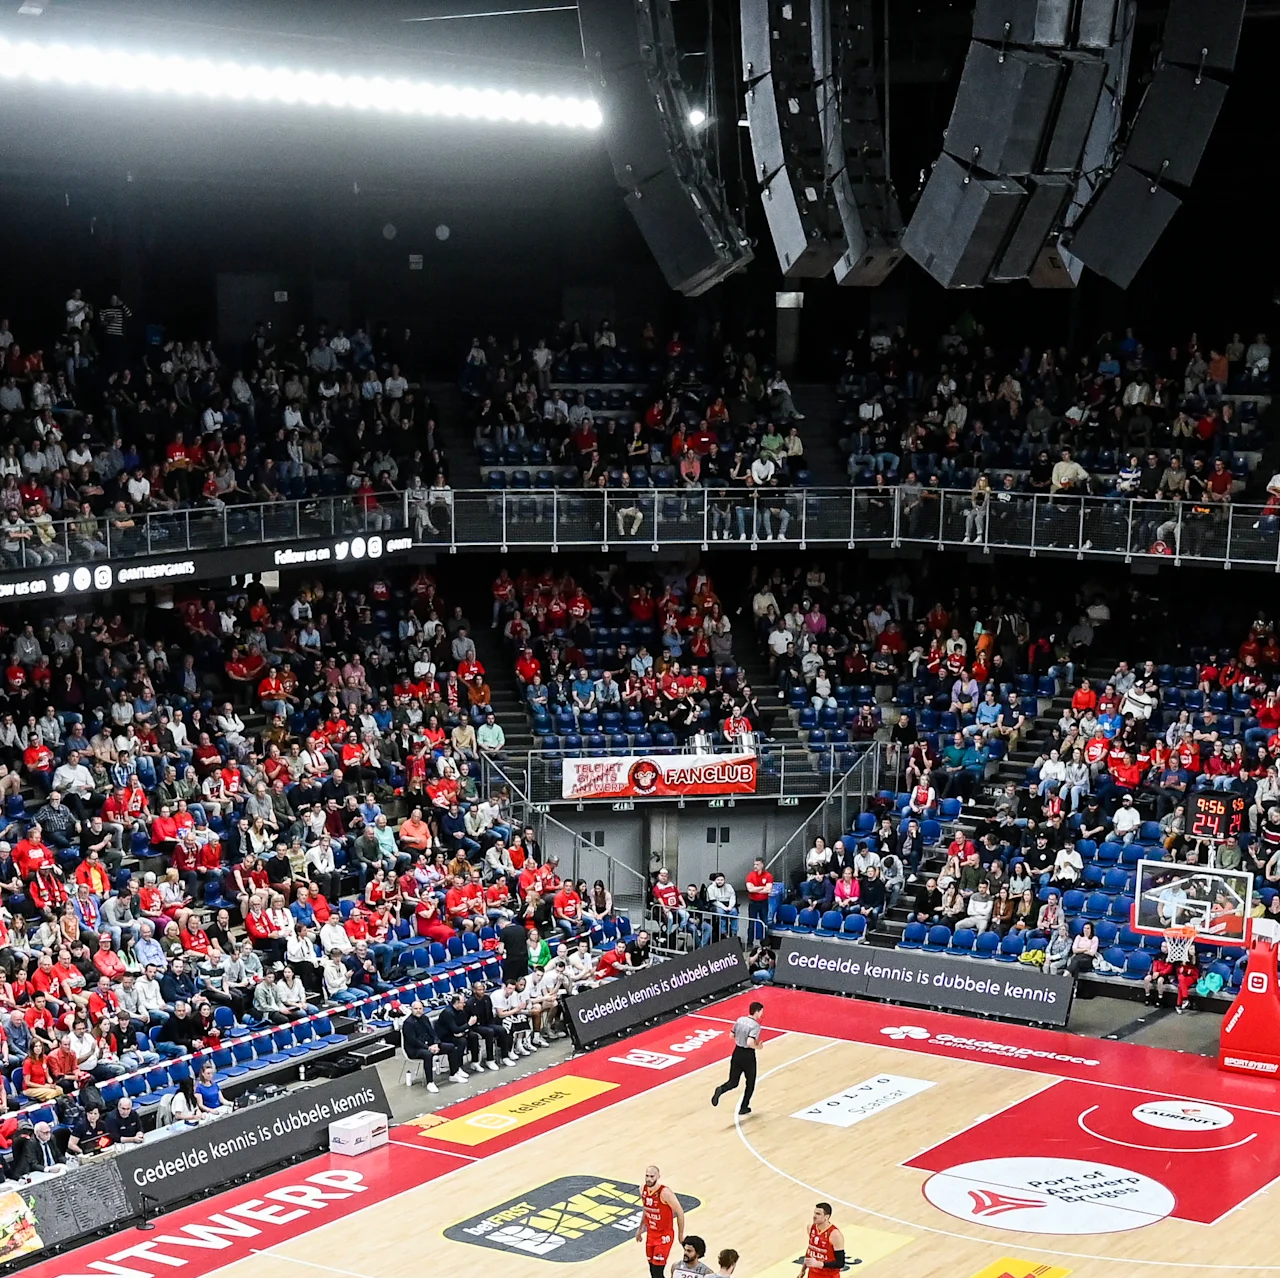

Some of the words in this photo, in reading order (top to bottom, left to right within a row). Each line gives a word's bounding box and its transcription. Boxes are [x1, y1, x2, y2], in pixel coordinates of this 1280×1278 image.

[274, 547, 305, 565] Follow
[305, 549, 317, 562] us
[317, 547, 330, 561] on
[15, 581, 30, 597] us
[30, 578, 47, 594] on
[117, 561, 195, 584] @ANTWERPGIANTS
[574, 763, 623, 774] TELENET
[577, 773, 617, 783] GIANTS
[664, 764, 754, 785] FANCLUB
[571, 782, 626, 793] ANTWERP
[1196, 798, 1225, 815] 9:56
[1193, 814, 1219, 835] 24
[1230, 814, 1242, 835] 24
[578, 994, 629, 1024] Gedeelde
[628, 982, 661, 1005] kennis
[660, 979, 671, 993] is
[670, 964, 709, 989] dubbele
[708, 952, 739, 973] kennis
[787, 951, 861, 976] Gedeelde
[864, 961, 914, 984] kennis
[917, 969, 929, 984] is
[932, 970, 1001, 996] dubbele
[1003, 980, 1057, 1005] kennis
[669, 1027, 726, 1053] Quick
[928, 1038, 977, 1051] CASINO
[509, 1090, 572, 1115] telenet
[848, 1089, 907, 1115] Scancar
[1138, 1108, 1222, 1127] LAURENTY
[133, 1149, 209, 1187] Gedeelde
[210, 1130, 258, 1160] kennis
[259, 1124, 272, 1142] is
[272, 1104, 331, 1137] dubbele
[332, 1087, 375, 1119] kennis
[1027, 1174, 1080, 1188] Port
[1083, 1170, 1107, 1180] of
[1046, 1175, 1141, 1196] Antwerp
[1058, 1186, 1140, 1204] Bruges
[462, 1201, 538, 1237] betFIRST
[661, 1235, 671, 1244] 30
